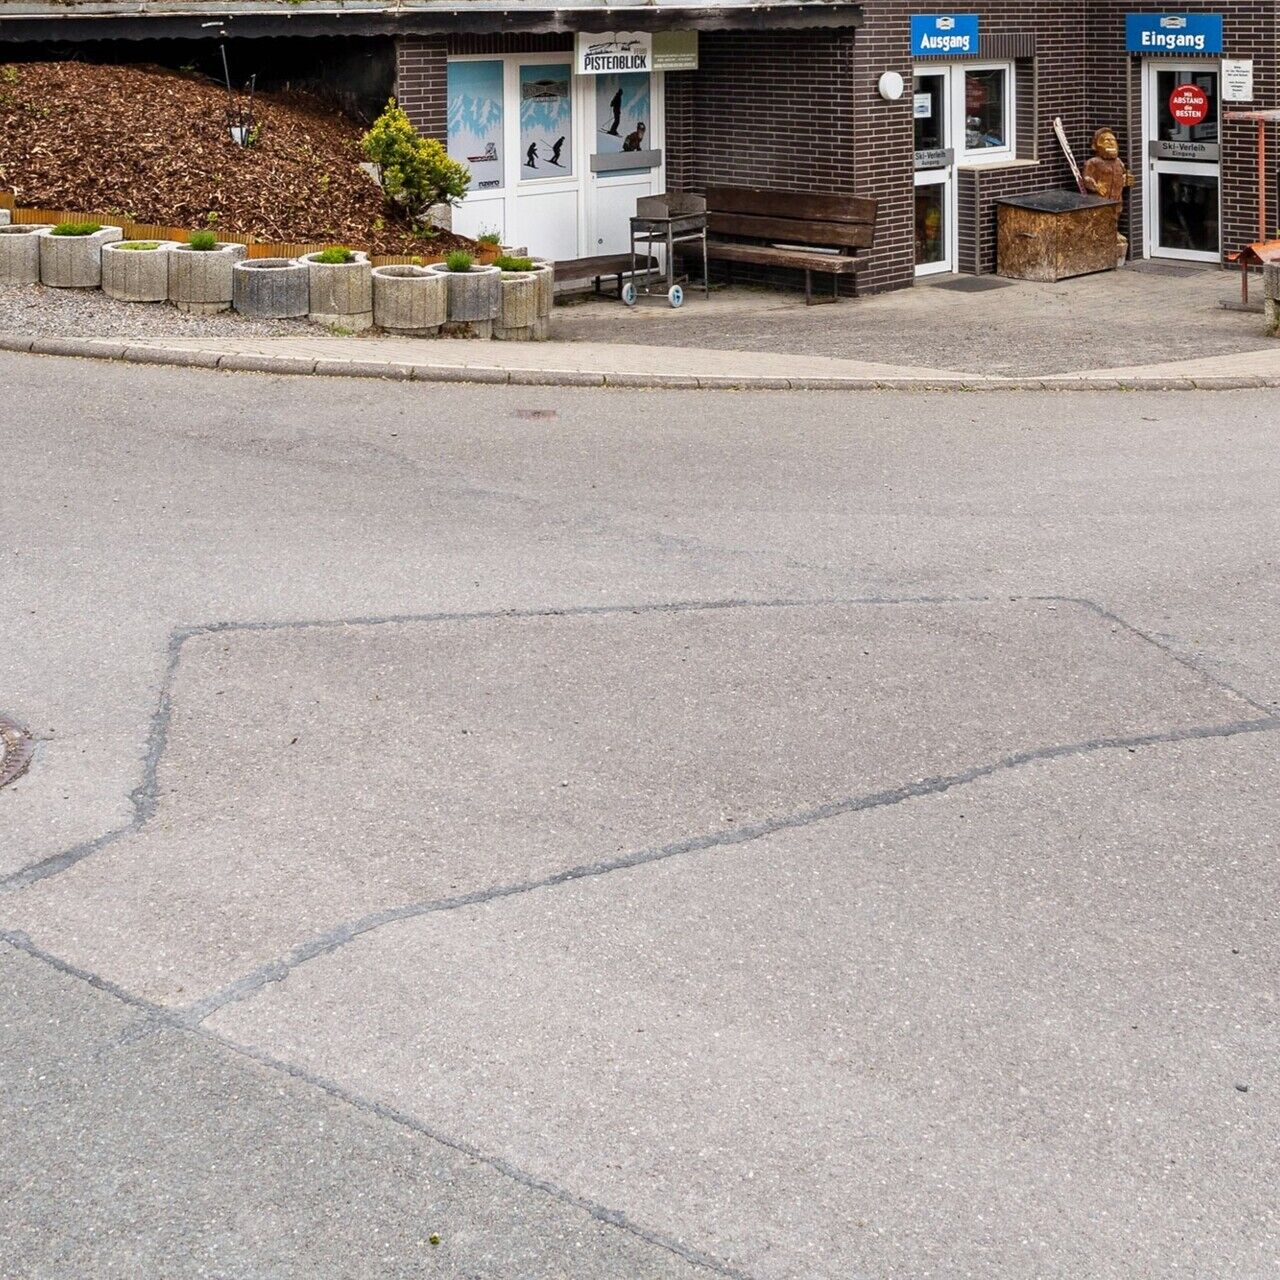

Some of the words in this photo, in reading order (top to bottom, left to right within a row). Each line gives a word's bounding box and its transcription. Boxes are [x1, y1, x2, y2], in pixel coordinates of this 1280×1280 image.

[920, 32, 970, 51] Ausgang
[1141, 31, 1206, 50] Eingang
[584, 55, 647, 70] PISTENBLICK
[1173, 97, 1204, 105] ABSTAND
[1175, 110, 1202, 118] BESTEN
[1162, 142, 1206, 152] Ski-Verleih
[915, 150, 947, 160] Ski-Verleih
